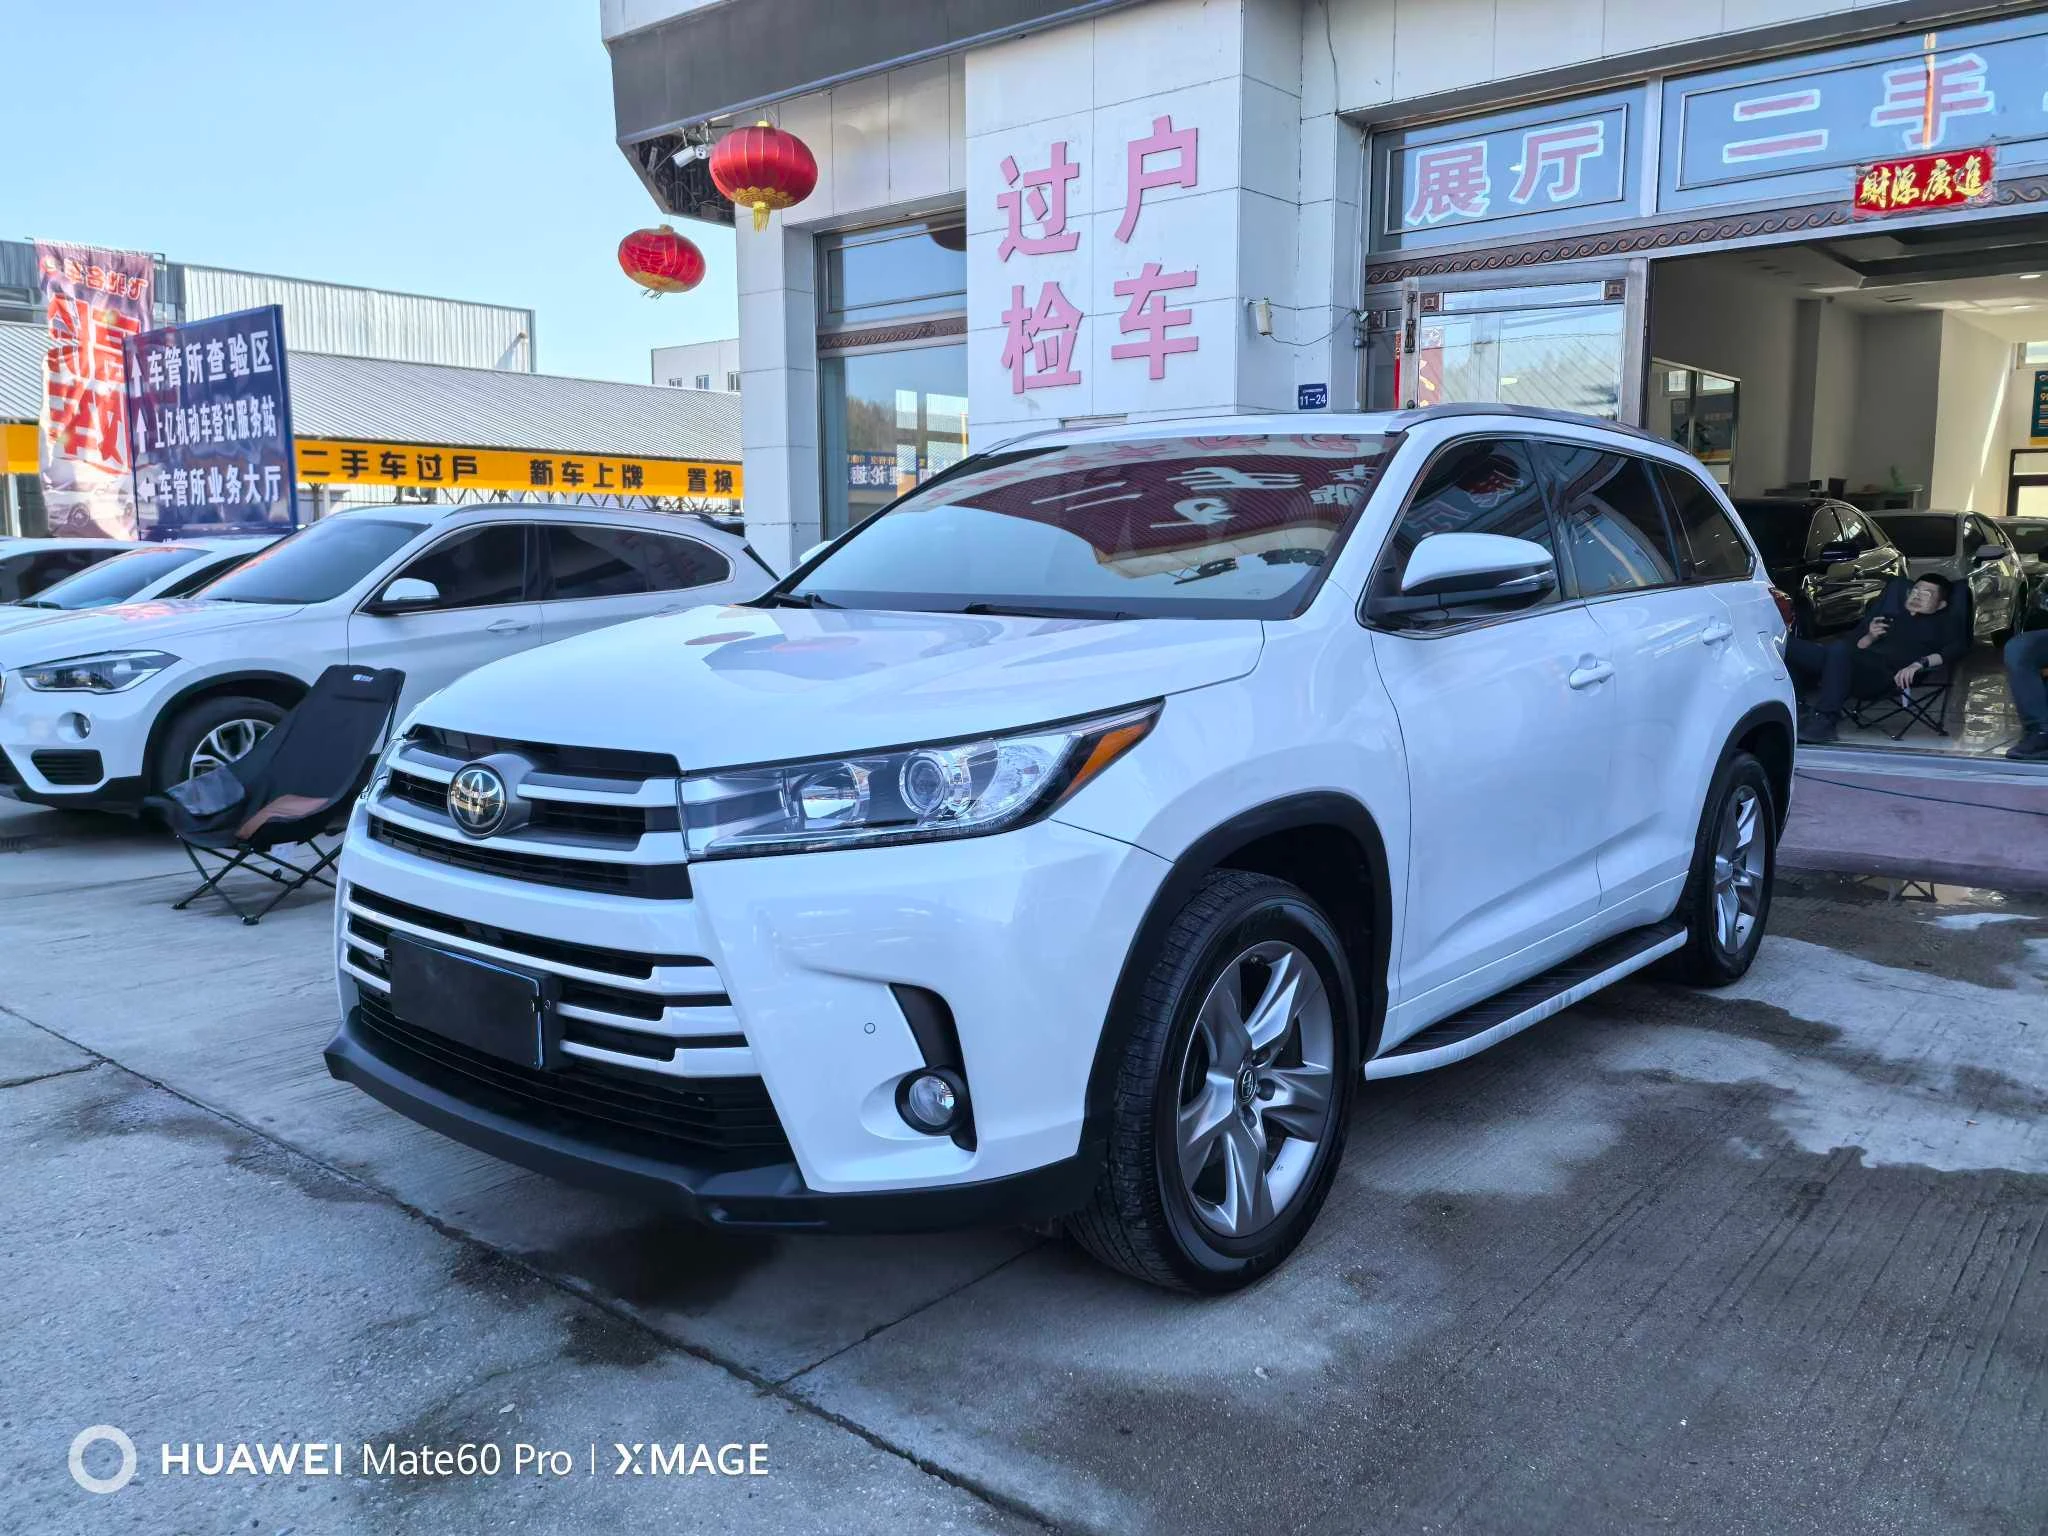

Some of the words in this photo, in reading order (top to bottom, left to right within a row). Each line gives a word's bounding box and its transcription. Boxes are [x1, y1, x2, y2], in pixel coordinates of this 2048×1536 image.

[1722, 53, 2048, 164] 二手
[997, 114, 1199, 262] 过户
[1404, 120, 1604, 225] 展厅
[1001, 262, 1200, 394] 检车
[147, 330, 273, 391] 车管所查验区
[155, 395, 277, 449] 上亿机动车登记服务站
[1299, 394, 1327, 406] 11-24
[158, 464, 281, 507] 车管所业务大厅
[301, 449, 478, 482] 二手车过户
[529, 458, 645, 488] 新车上牌
[687, 468, 734, 494] 置换
